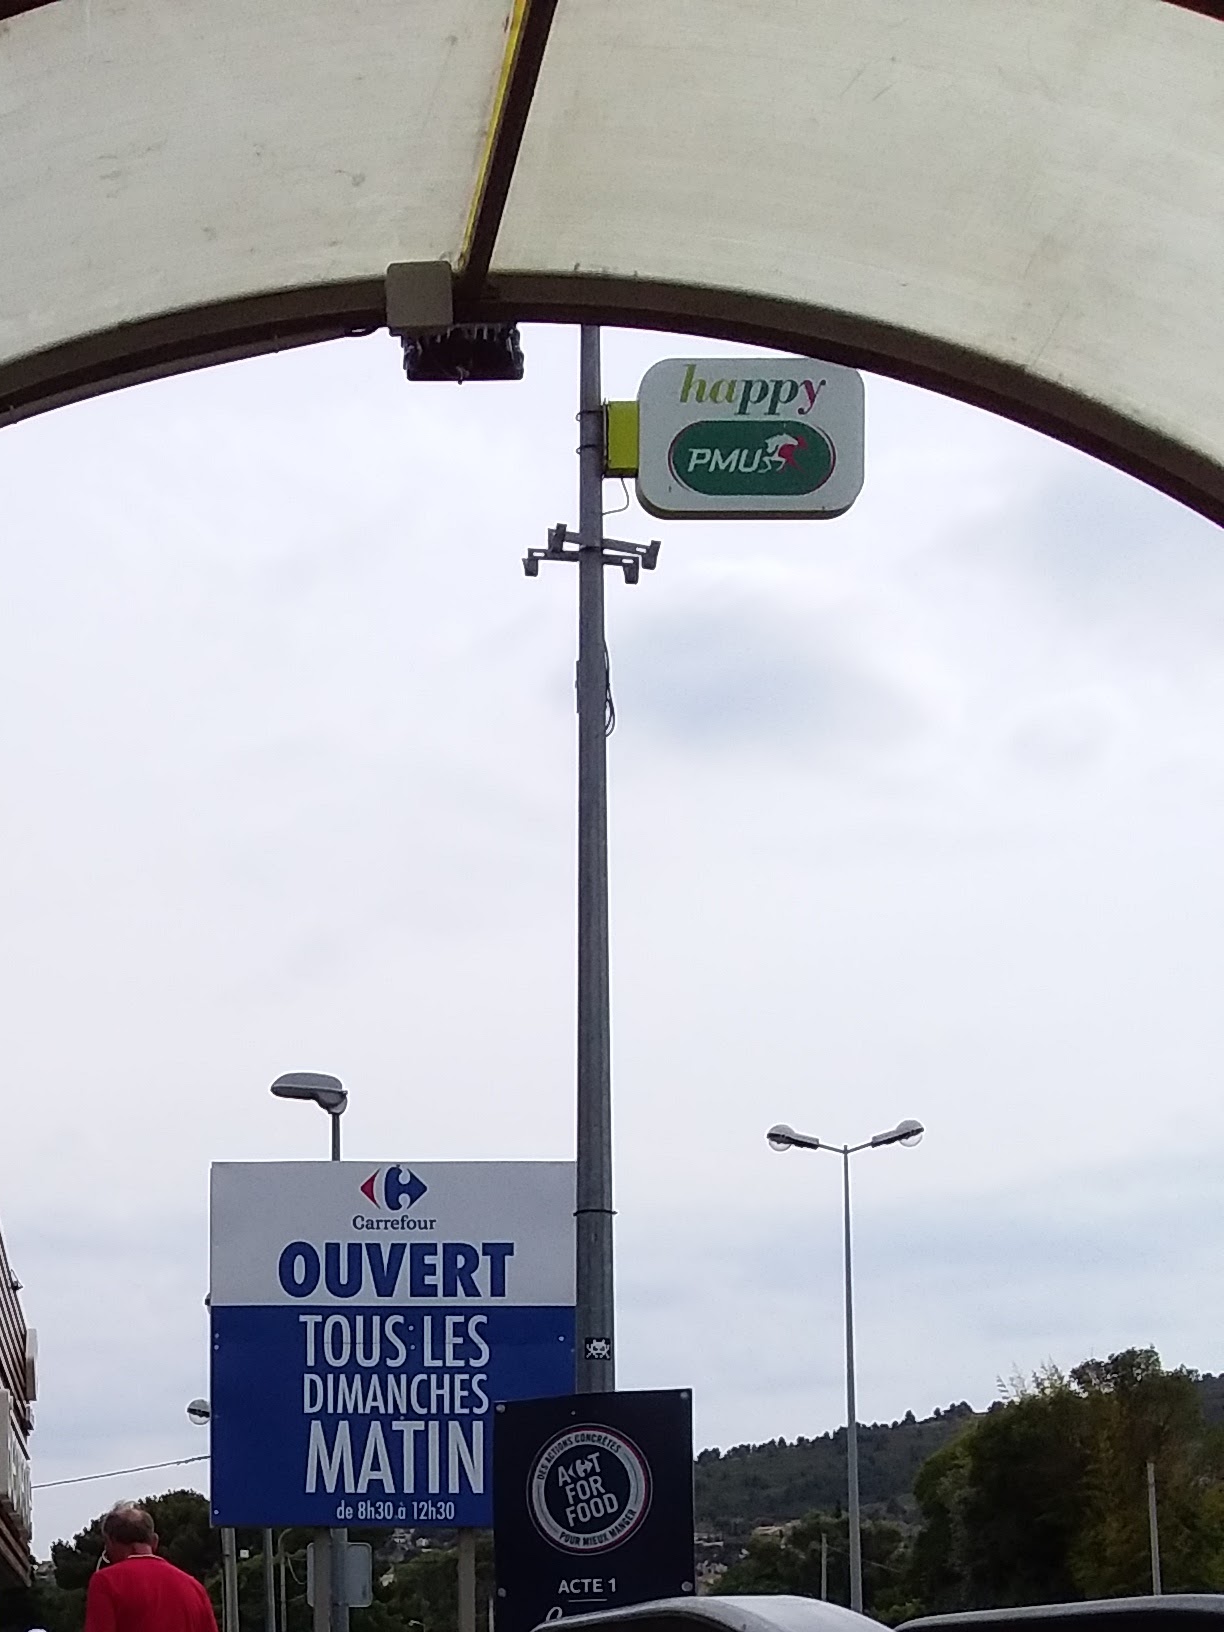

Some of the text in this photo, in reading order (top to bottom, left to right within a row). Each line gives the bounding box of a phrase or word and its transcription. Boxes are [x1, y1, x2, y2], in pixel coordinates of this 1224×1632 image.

[679, 364, 826, 415] happy
[687, 448, 764, 473] PMU
[352, 1214, 437, 1231] Carrefour
[278, 1241, 515, 1298] OUVERT
[298, 1314, 490, 1367] TOUS LES
[303, 1373, 490, 1415] DIMANCHES
[305, 1420, 485, 1494] MATIN
[547, 1436, 573, 1463] ACTIONS
[564, 1475, 606, 1505] FOR
[336, 1500, 455, 1520] de 8h30 à 12h30
[559, 1508, 637, 1547] POUR MIEUX MANGER
[564, 1492, 620, 1528] FOOD
[558, 1577, 616, 1595] ACTE 1
